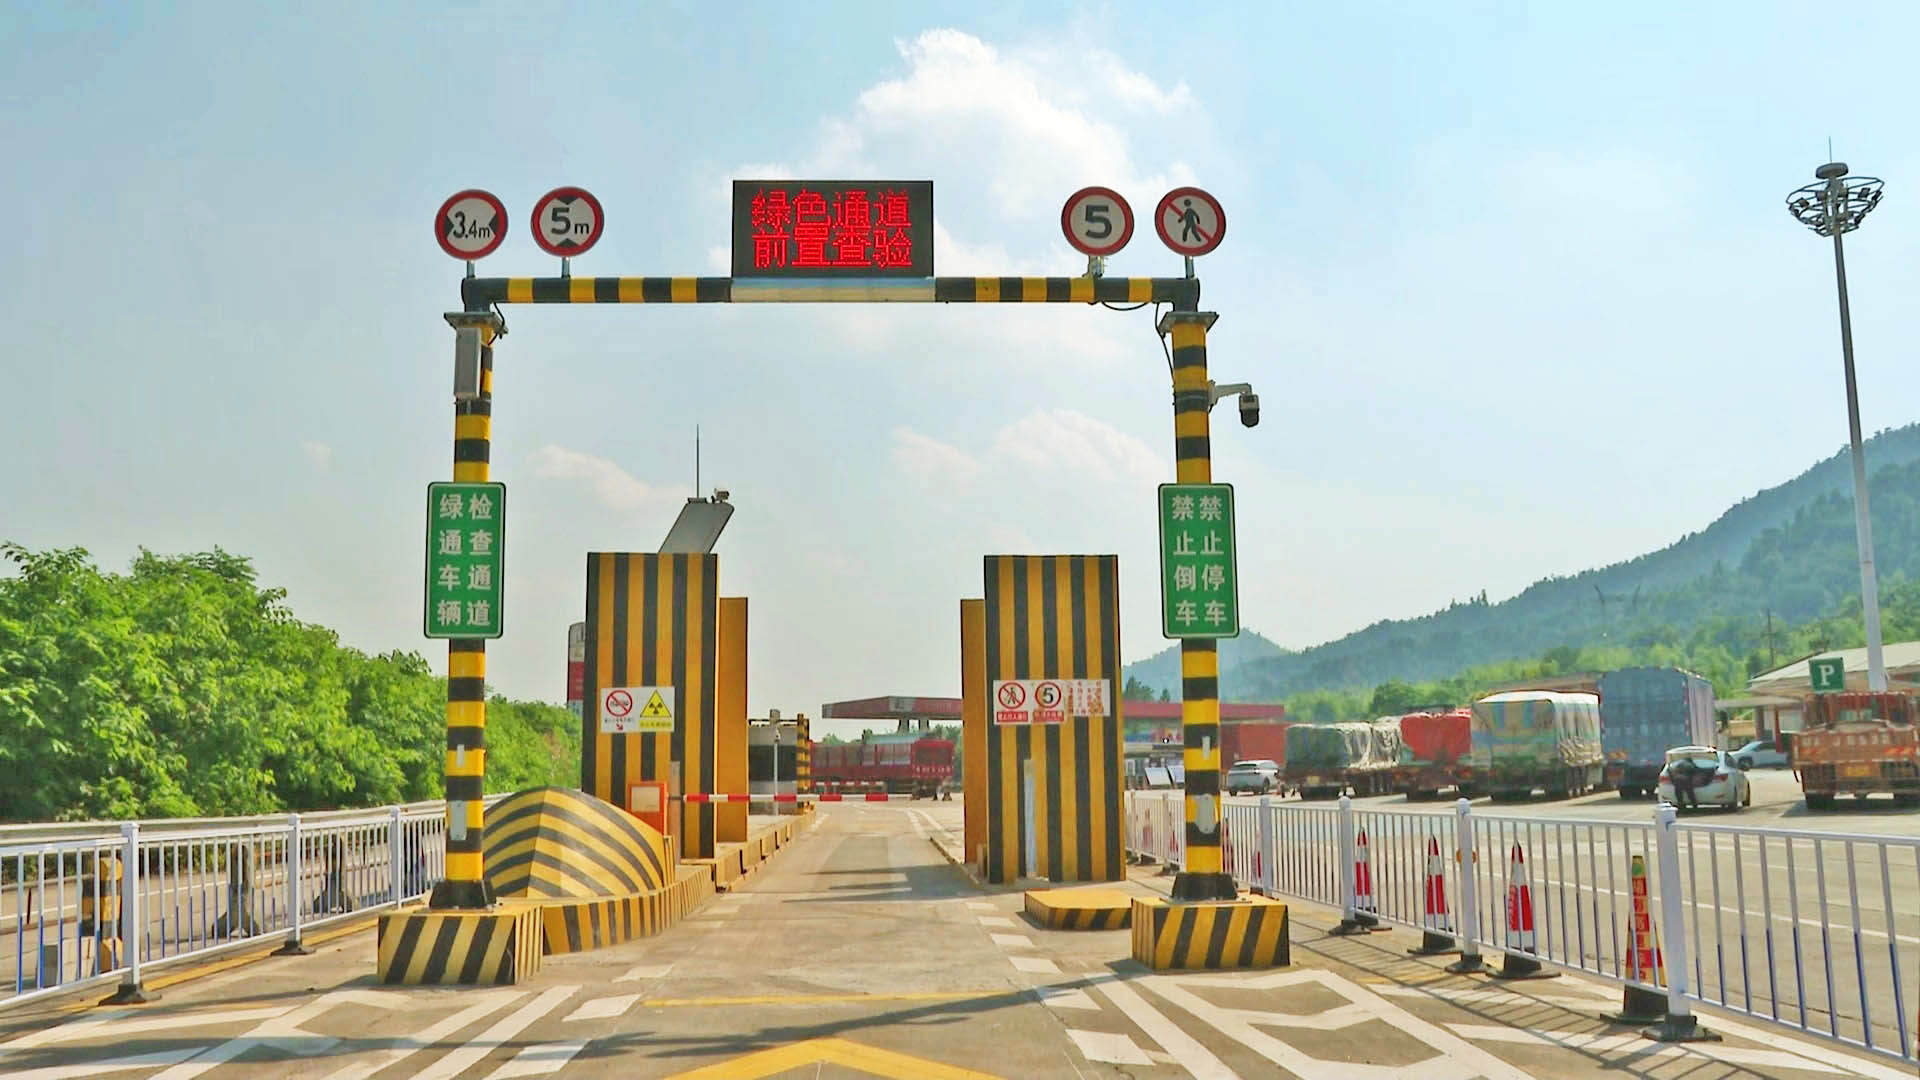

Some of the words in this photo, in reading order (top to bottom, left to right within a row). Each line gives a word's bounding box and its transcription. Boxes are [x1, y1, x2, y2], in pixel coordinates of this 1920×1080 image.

[452, 211, 490, 239] 3.4m
[752, 187, 912, 229] 绿色通道
[1085, 204, 1112, 239] 5
[752, 227, 912, 269] 前置查验
[437, 493, 463, 627] 绿通车辆
[467, 493, 492, 627] 检查通道
[1172, 495, 1198, 627] 禁止倒车
[1200, 495, 1227, 627] 禁止停车
[1042, 687, 1054, 704] 5
[1818, 664, 1835, 686] P
